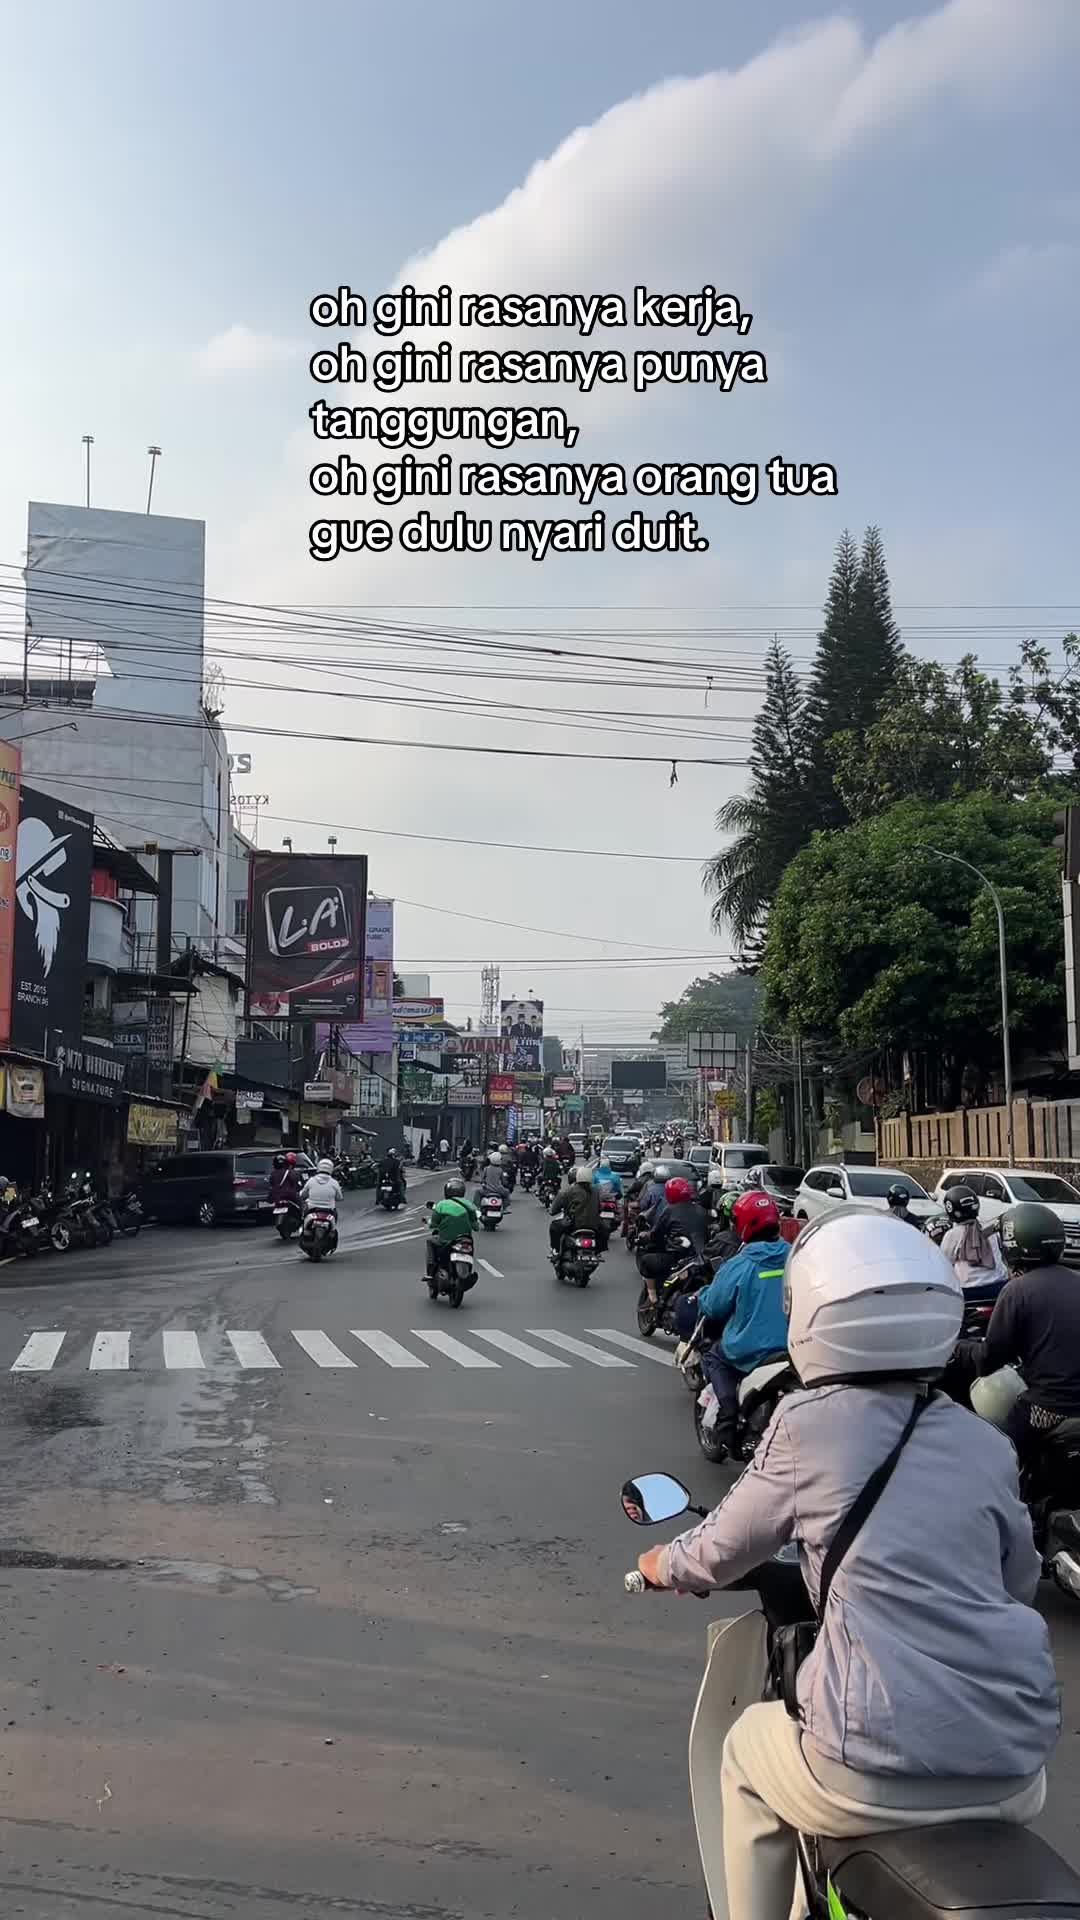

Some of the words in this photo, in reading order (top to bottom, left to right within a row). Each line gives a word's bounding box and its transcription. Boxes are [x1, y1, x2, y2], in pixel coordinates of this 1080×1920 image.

[311, 940, 340, 952] BOLD
[33, 984, 47, 995] 2015
[460, 1038, 513, 1054] YAMAHA
[71, 1078, 114, 1098] SIGNATURE
